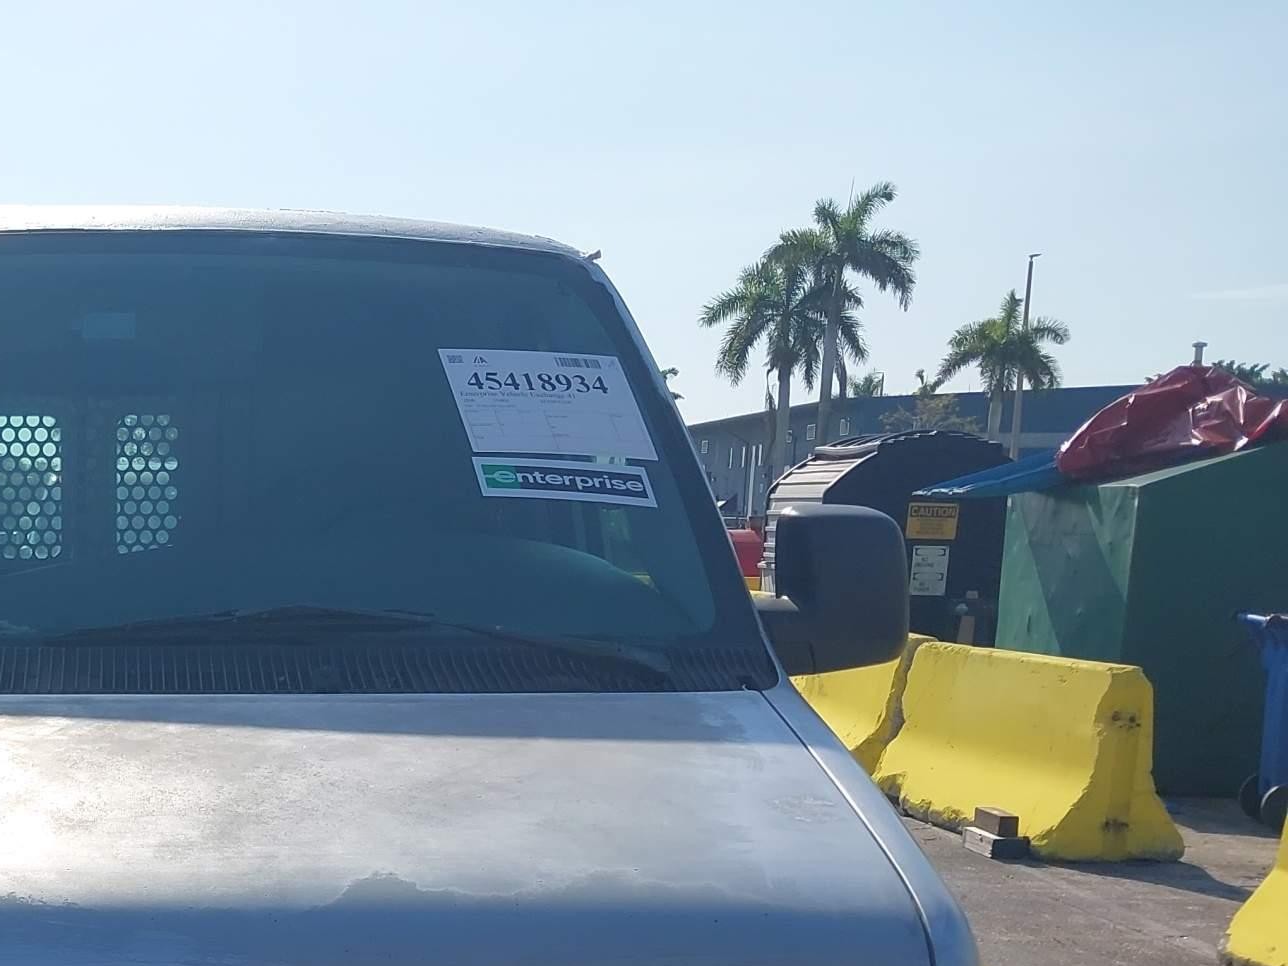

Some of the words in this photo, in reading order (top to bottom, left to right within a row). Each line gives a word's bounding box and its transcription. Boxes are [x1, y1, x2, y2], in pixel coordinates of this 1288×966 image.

[467, 372, 609, 394] 45418934
[487, 469, 645, 492] enterprise
[911, 505, 956, 517] CAUTION
